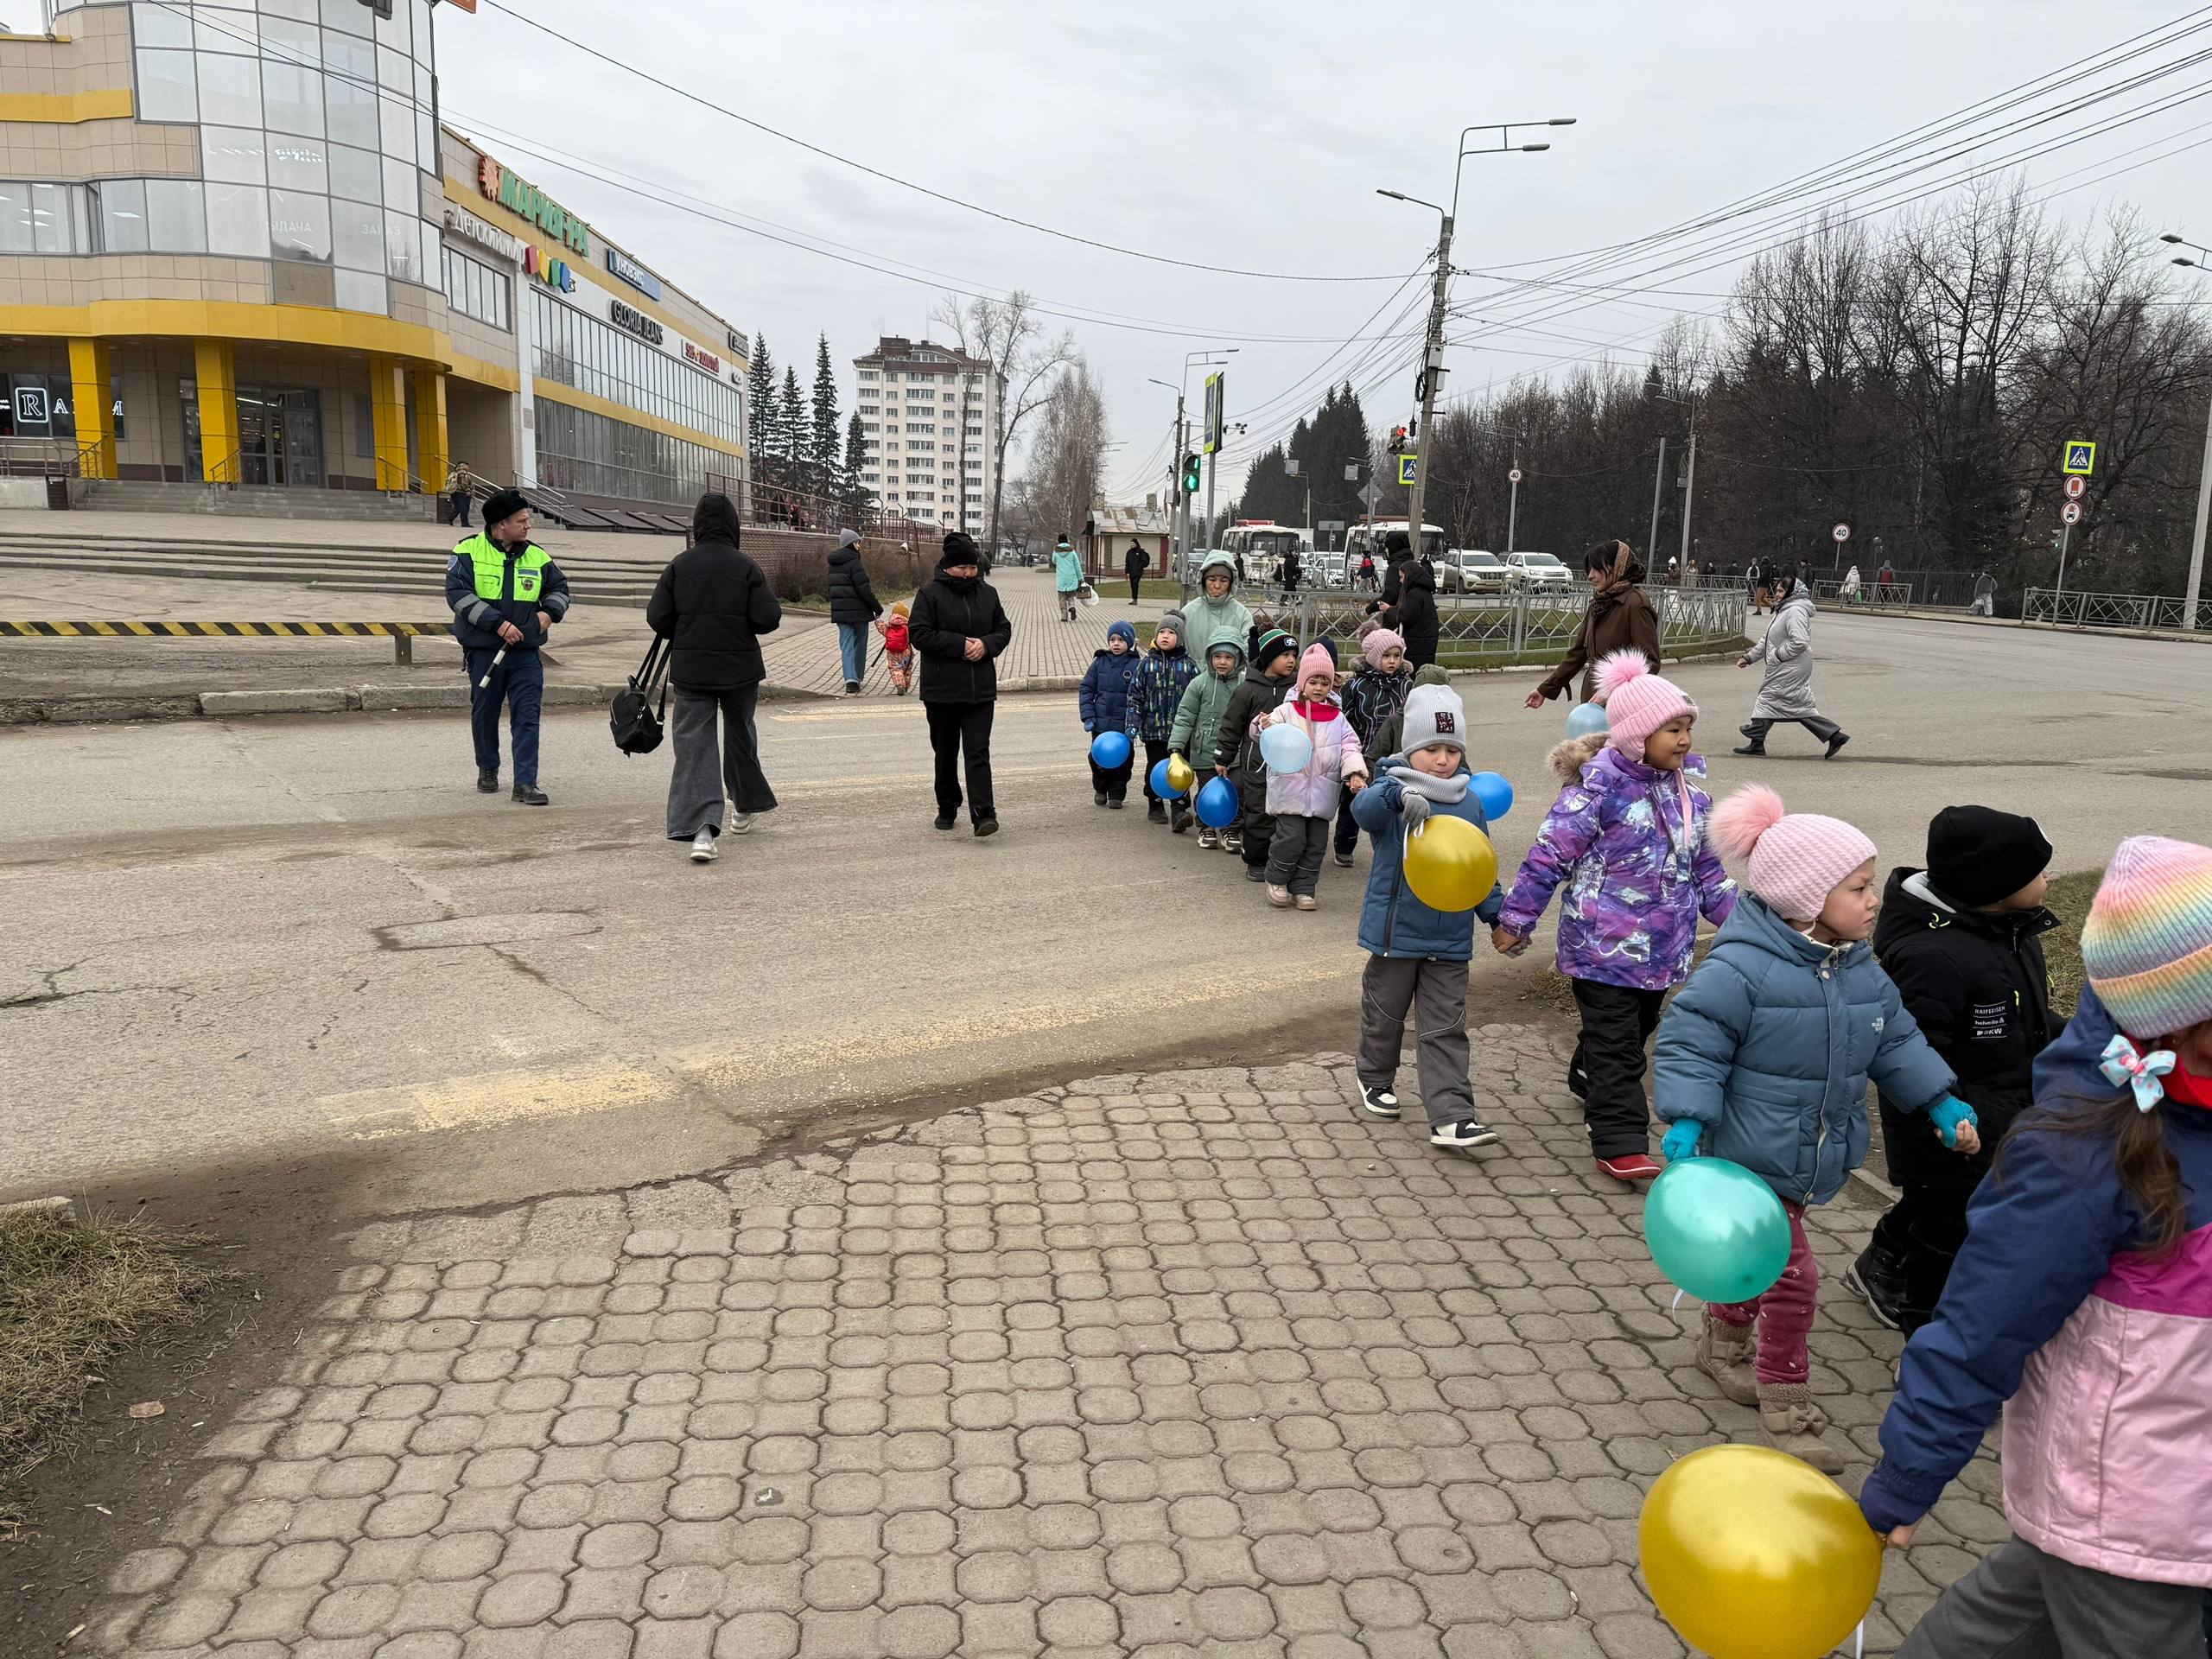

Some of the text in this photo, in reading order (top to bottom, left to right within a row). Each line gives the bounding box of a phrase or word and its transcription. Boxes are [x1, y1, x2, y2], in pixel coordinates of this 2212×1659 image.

[501, 168, 589, 257] МАРИЯ-РА
[613, 300, 664, 345] GLORIA JEANS
